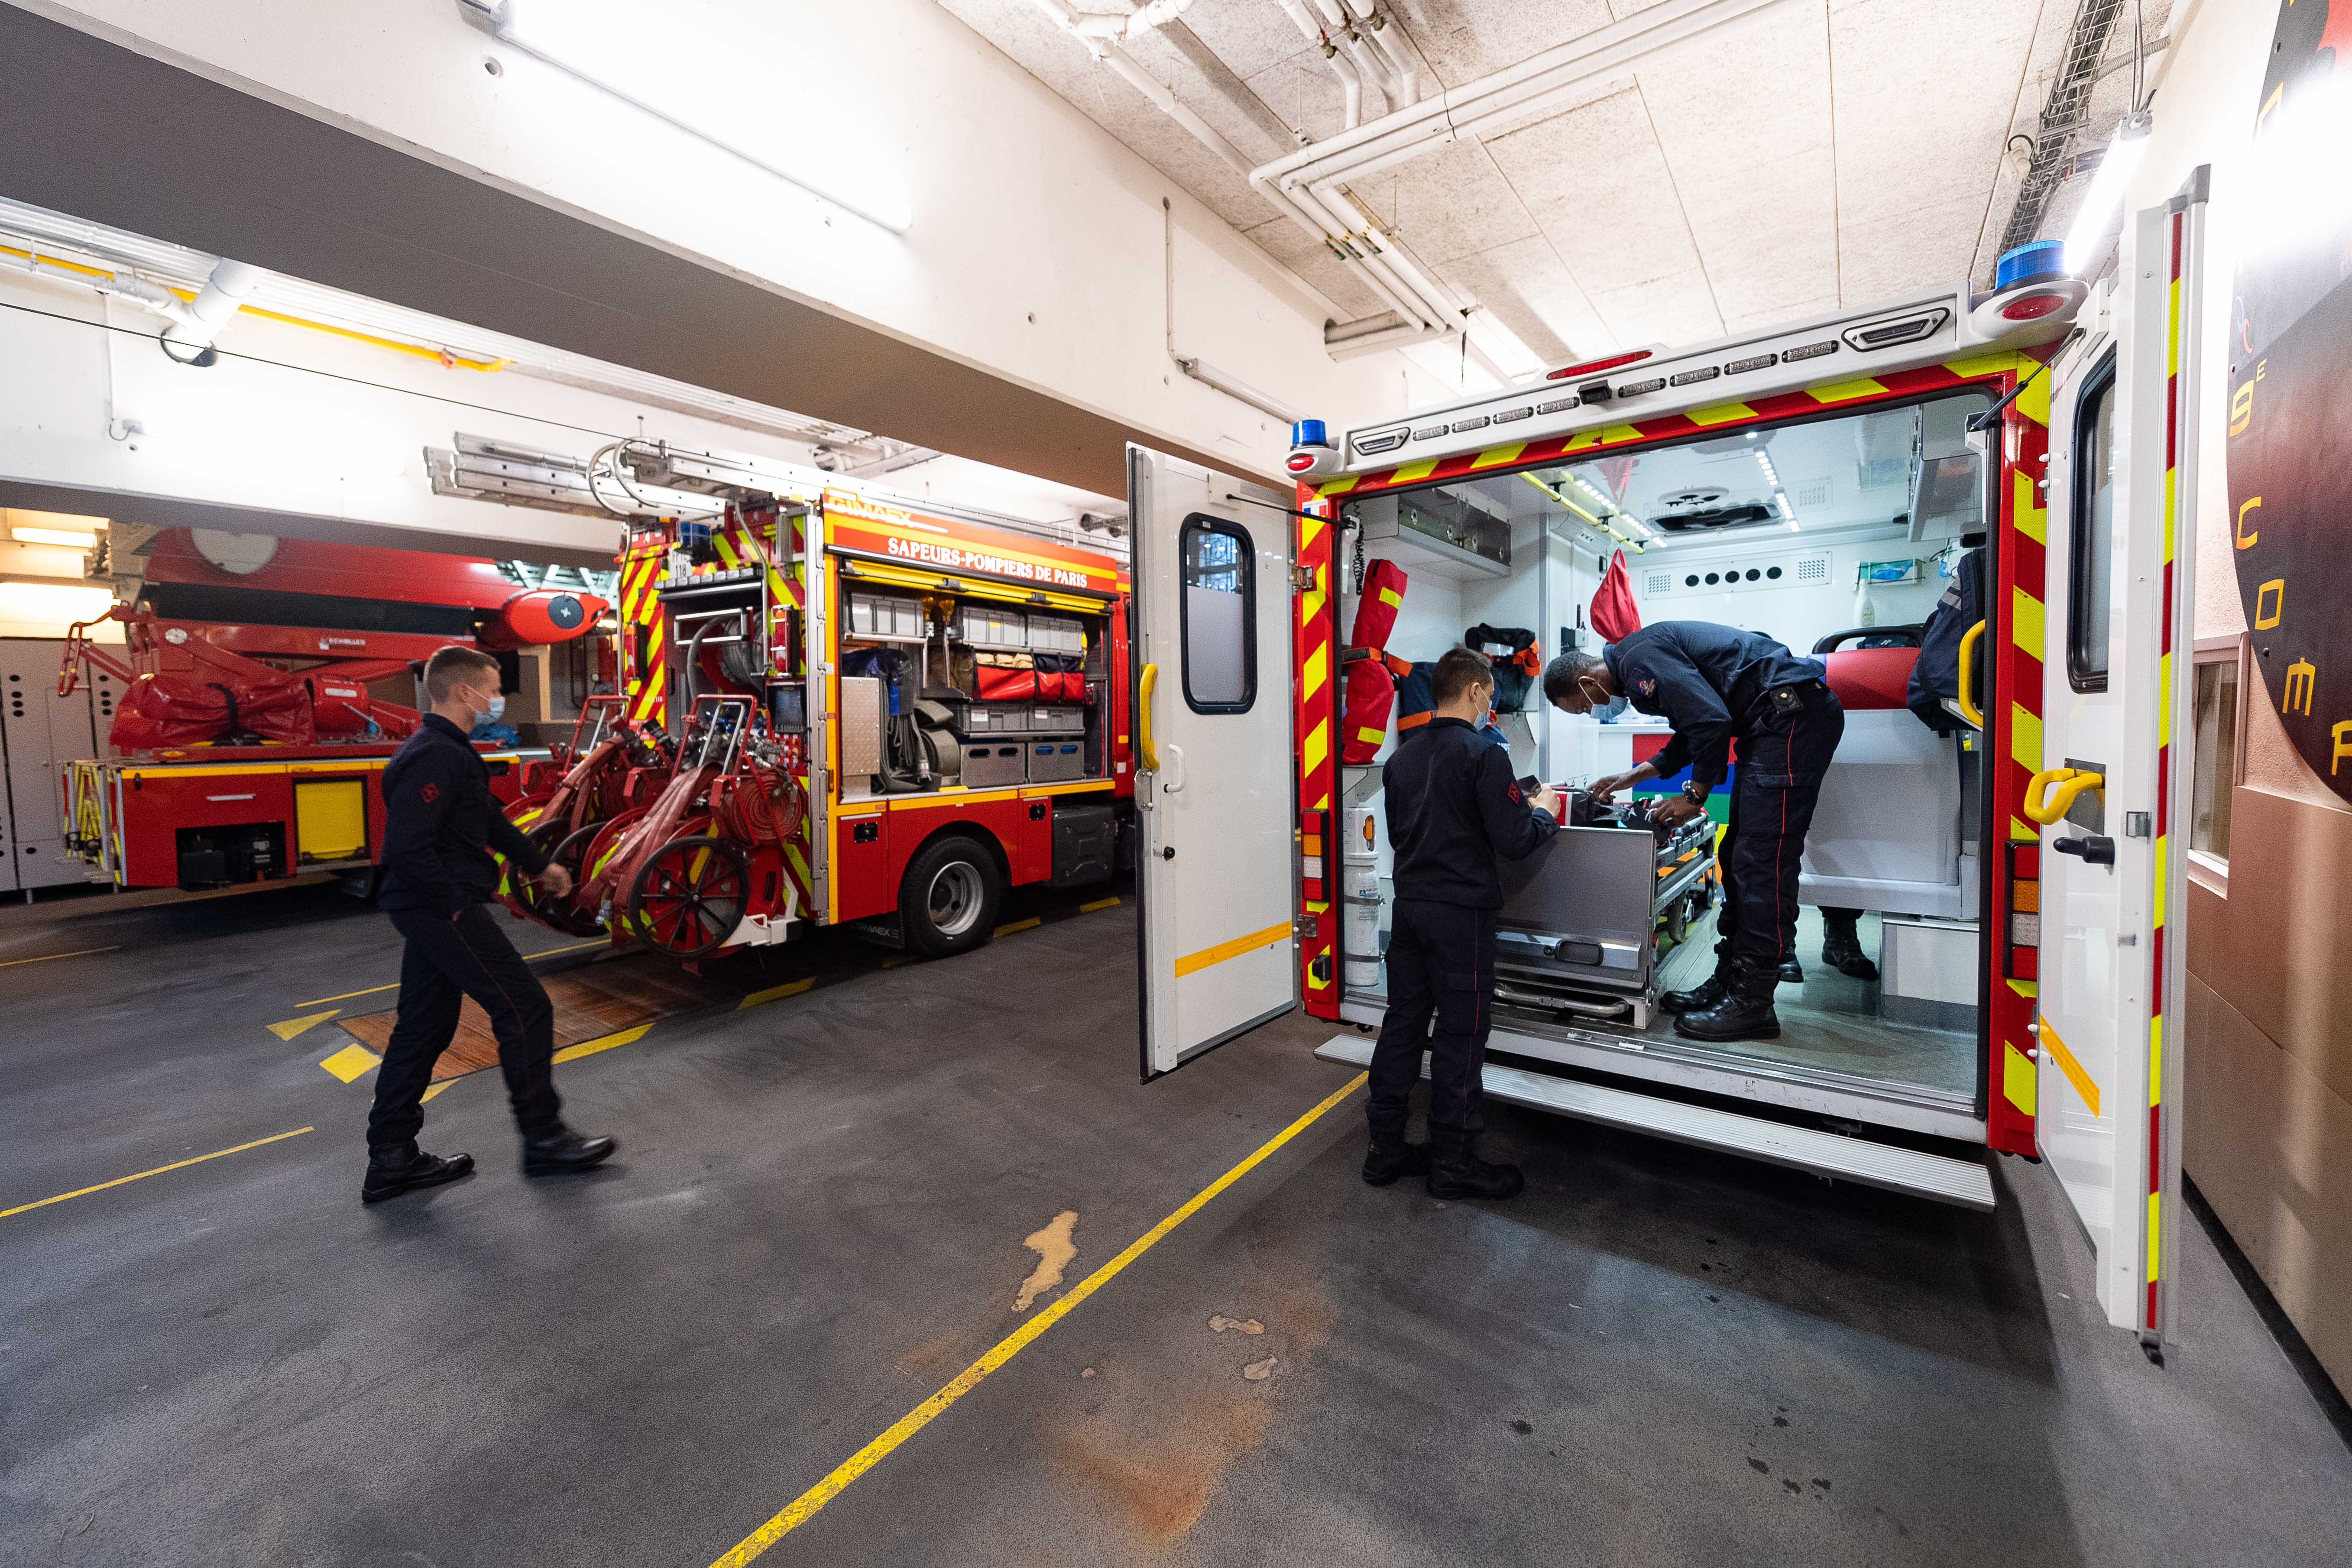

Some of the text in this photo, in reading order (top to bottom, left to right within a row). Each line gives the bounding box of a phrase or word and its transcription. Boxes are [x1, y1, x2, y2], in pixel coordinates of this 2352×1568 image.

[675, 564, 687, 578] 118
[888, 537, 1087, 588] SAPEURS-POMPIERS DE PARIS
